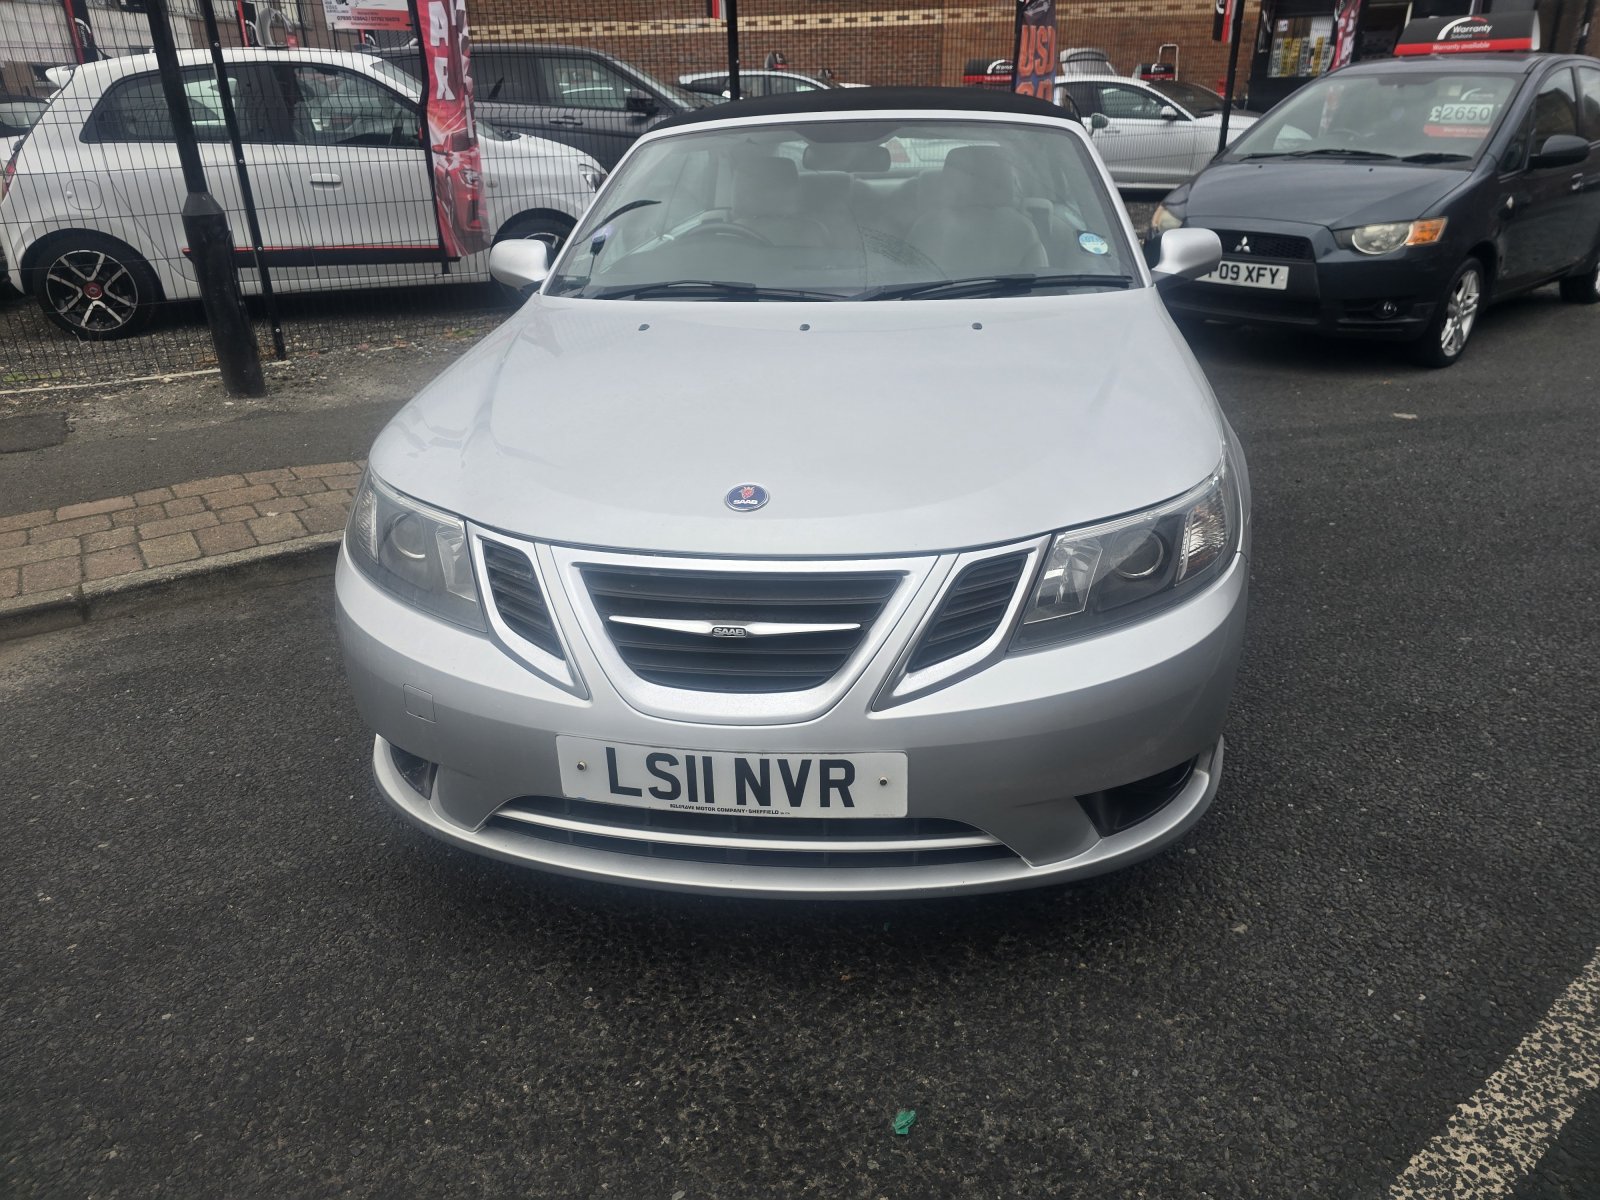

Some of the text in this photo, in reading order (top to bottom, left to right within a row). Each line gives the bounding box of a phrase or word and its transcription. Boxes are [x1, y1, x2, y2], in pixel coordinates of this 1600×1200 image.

[1452, 25, 1492, 34] Warranty
[1461, 42, 1490, 50] available
[1429, 105, 1491, 122] £2650
[1244, 265, 1280, 285] XFY
[713, 627, 745, 636] SAAB
[734, 757, 856, 808] NVR
